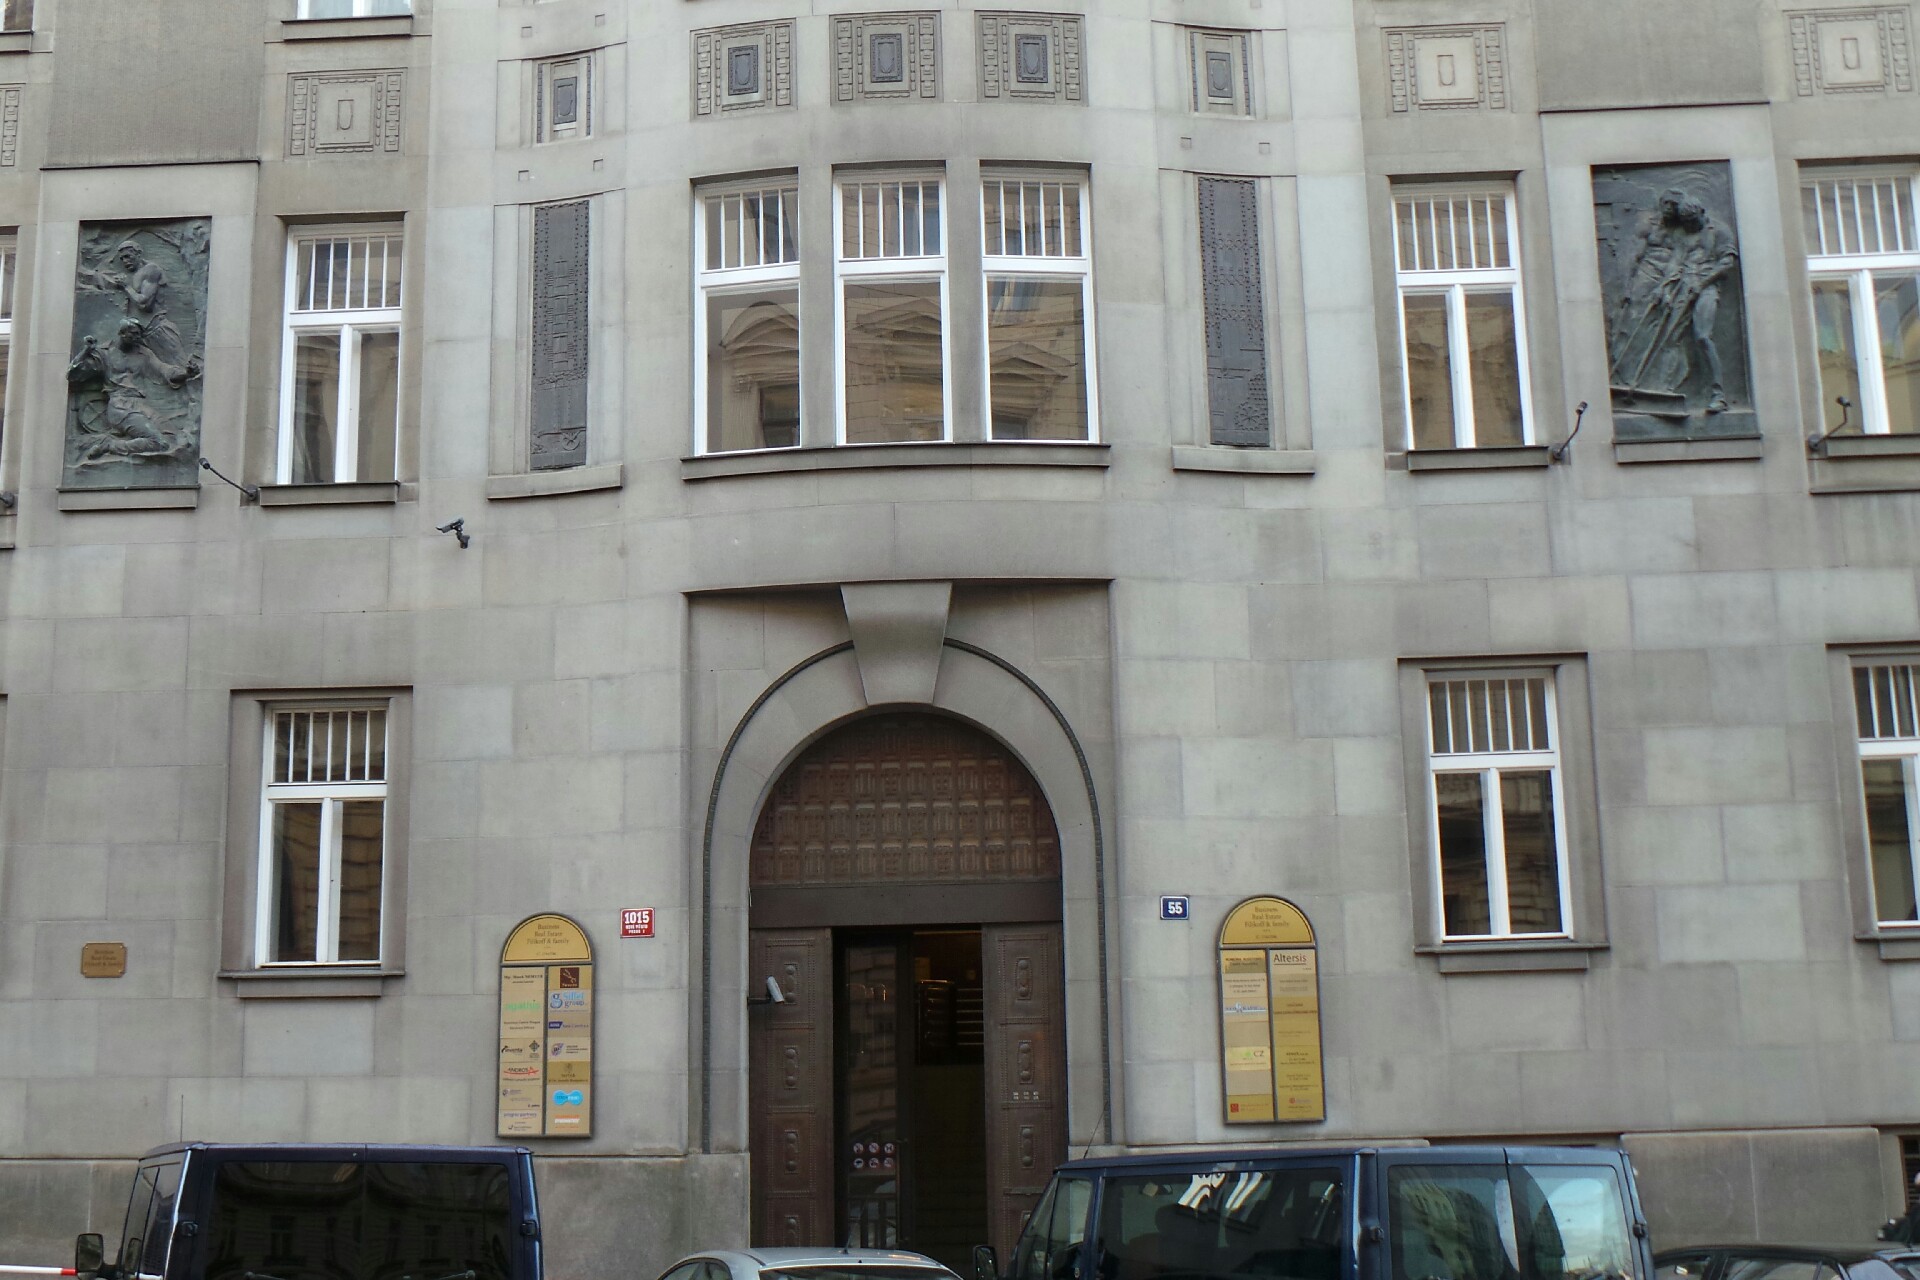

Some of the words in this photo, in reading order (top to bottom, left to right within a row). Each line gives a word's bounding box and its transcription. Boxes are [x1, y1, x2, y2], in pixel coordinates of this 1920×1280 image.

[1168, 901, 1183, 915] 55
[624, 911, 650, 924] 1015
[1273, 953, 1307, 963] Altersis
